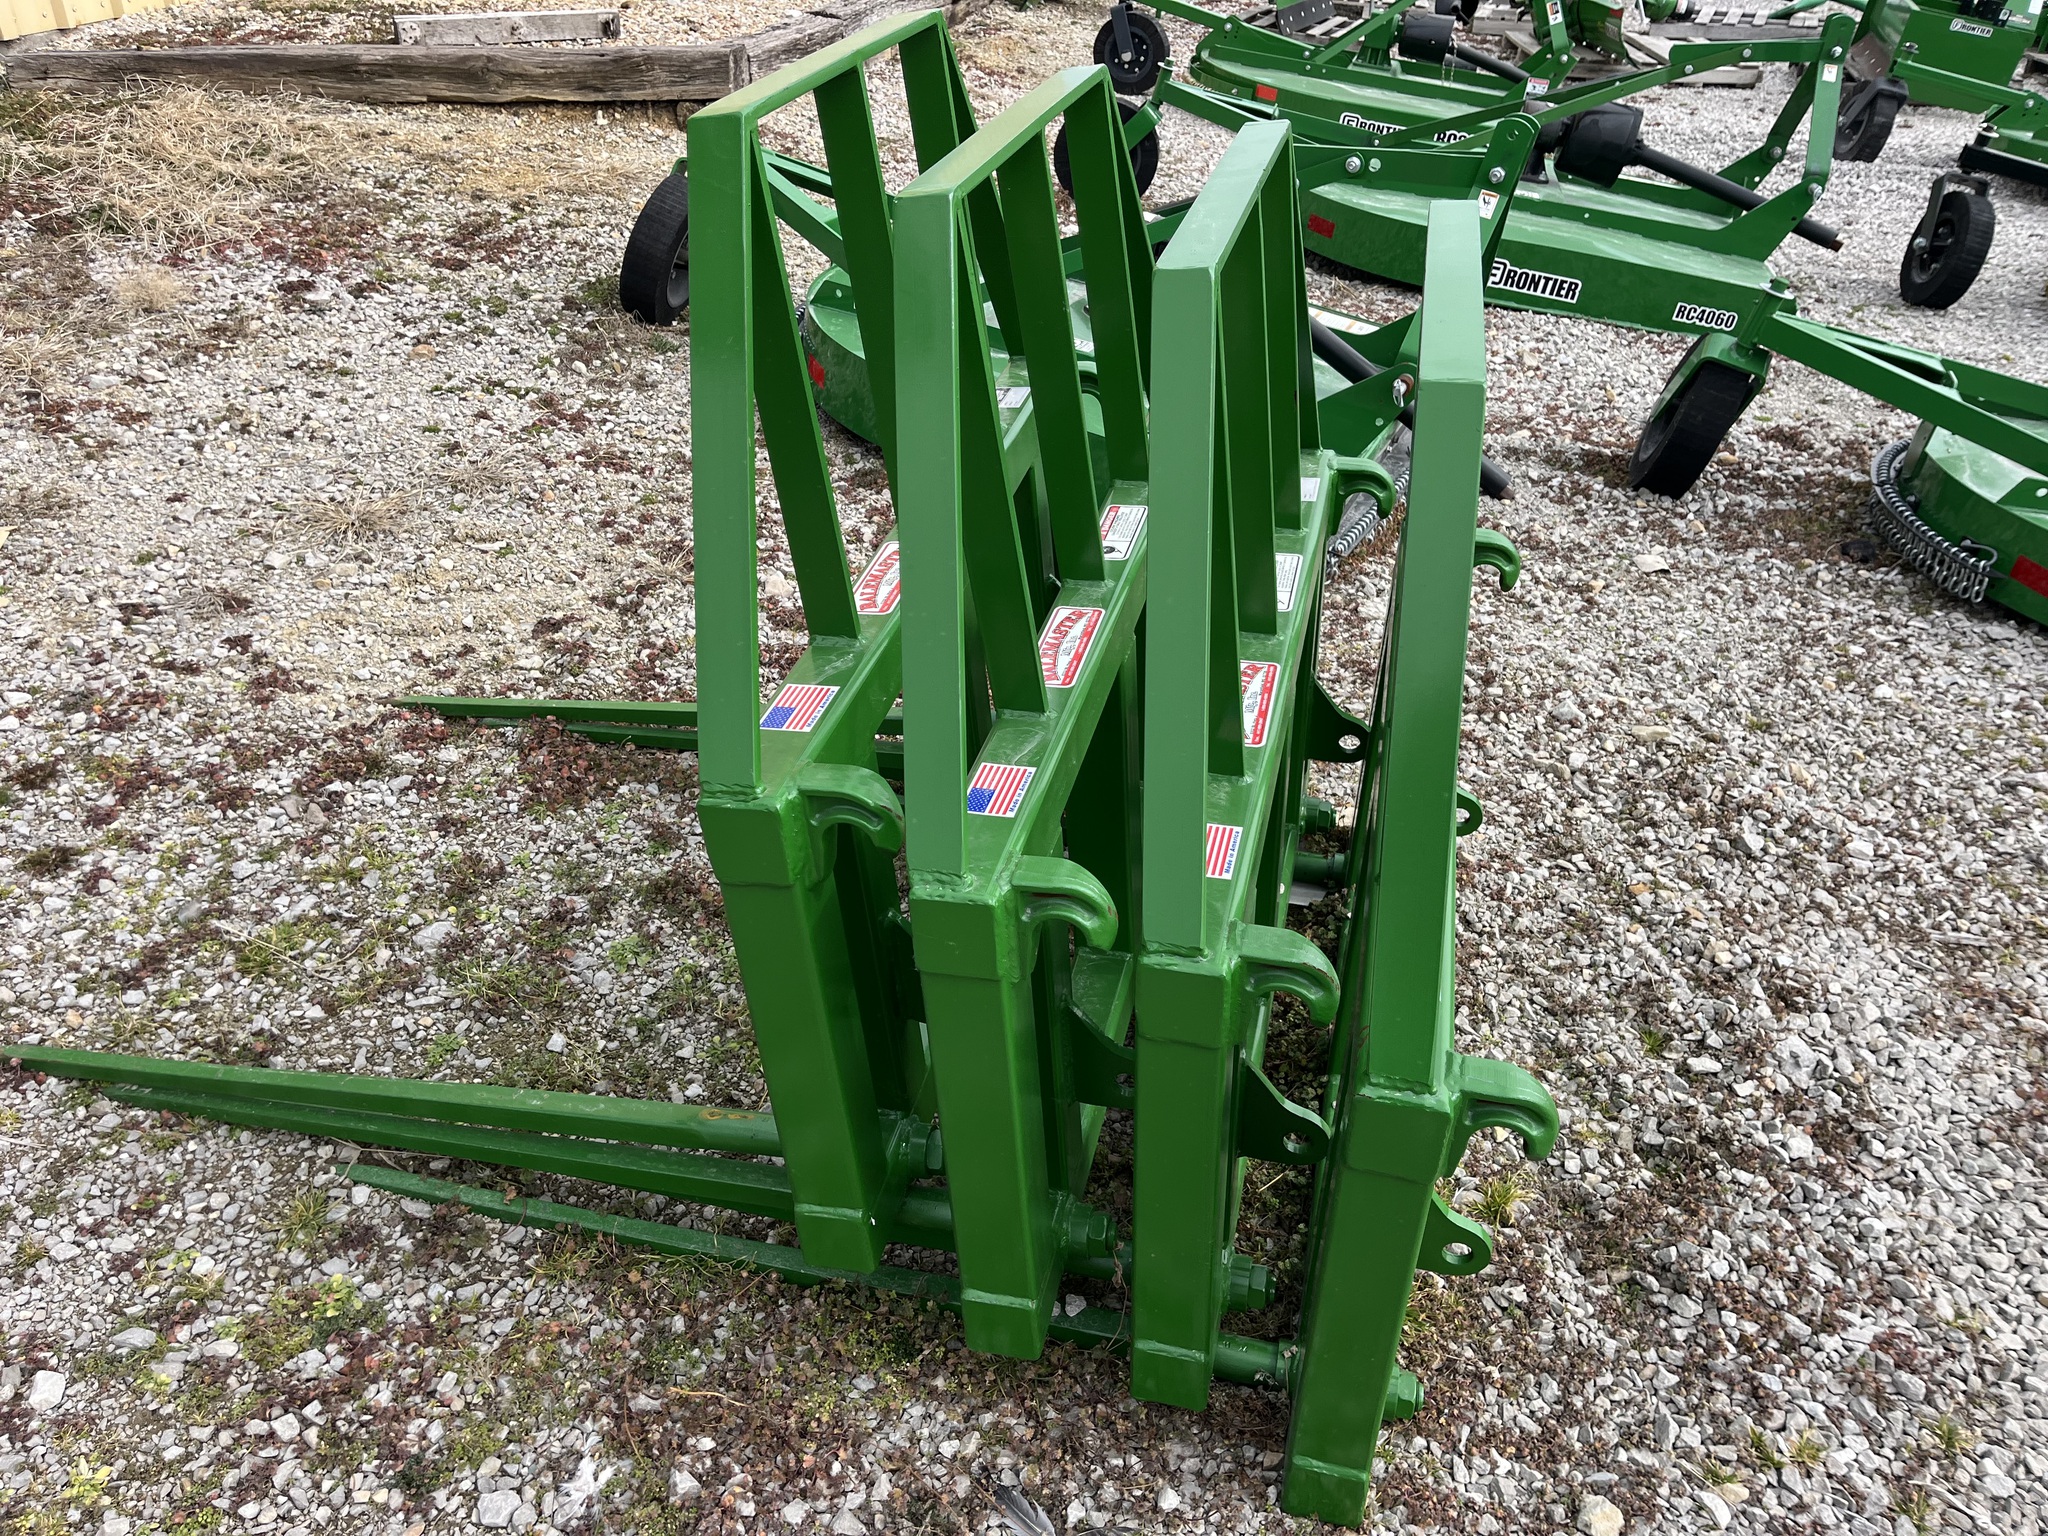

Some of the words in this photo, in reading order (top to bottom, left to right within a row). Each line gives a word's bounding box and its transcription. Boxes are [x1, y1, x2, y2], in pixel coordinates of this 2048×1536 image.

[1952, 20, 1991, 35] FRONTIER
[1675, 304, 1736, 328] RC4060
[806, 715, 818, 727] Made
[820, 690, 836, 709] America
[1009, 799, 1020, 812] Made
[1019, 771, 1033, 791] America
[1224, 860, 1233, 874] Made
[1230, 831, 1240, 852] America
